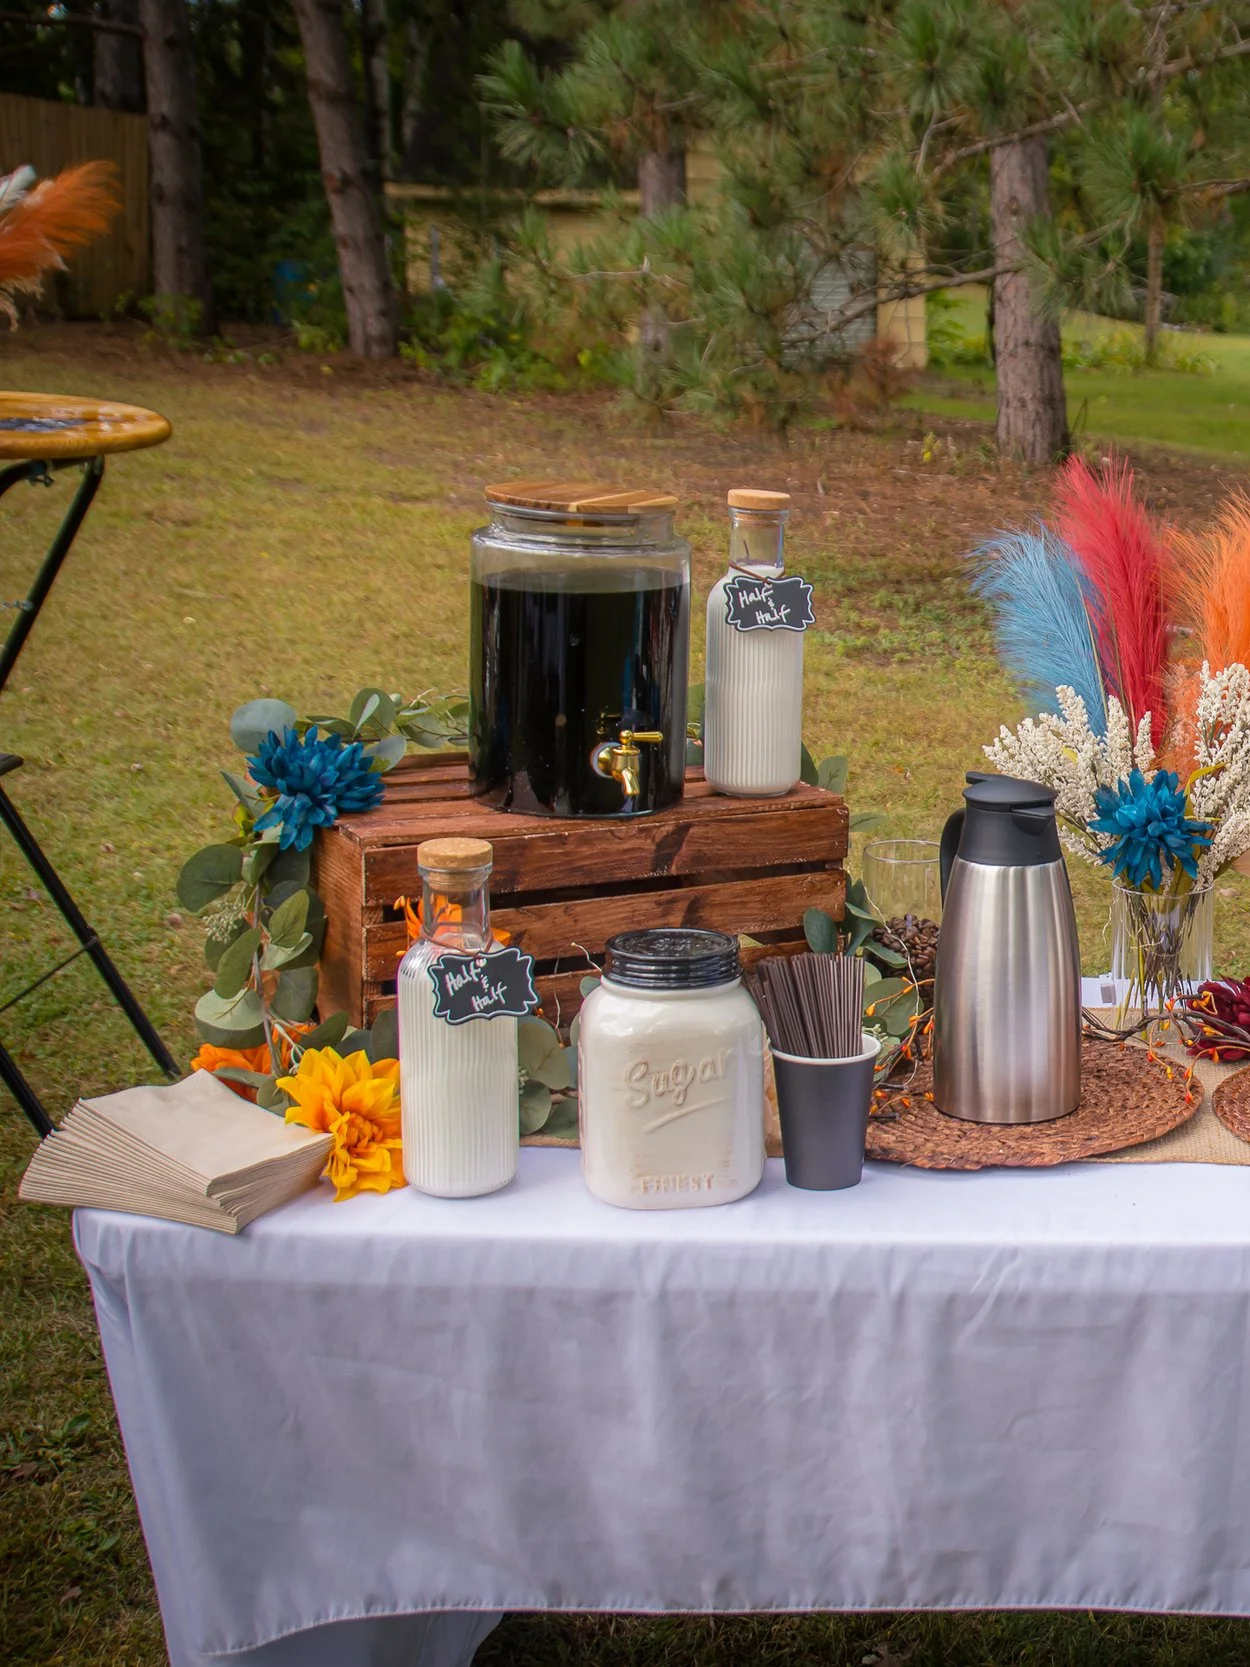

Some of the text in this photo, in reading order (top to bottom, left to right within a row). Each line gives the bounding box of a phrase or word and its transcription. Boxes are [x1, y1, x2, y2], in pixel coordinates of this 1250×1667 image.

[738, 586, 773, 608] Half
[755, 604, 791, 624] Half
[445, 961, 481, 996] Half
[471, 981, 507, 1012] Half
[623, 1047, 733, 1108] Sugar
[640, 1174, 715, 1195] FINEST
